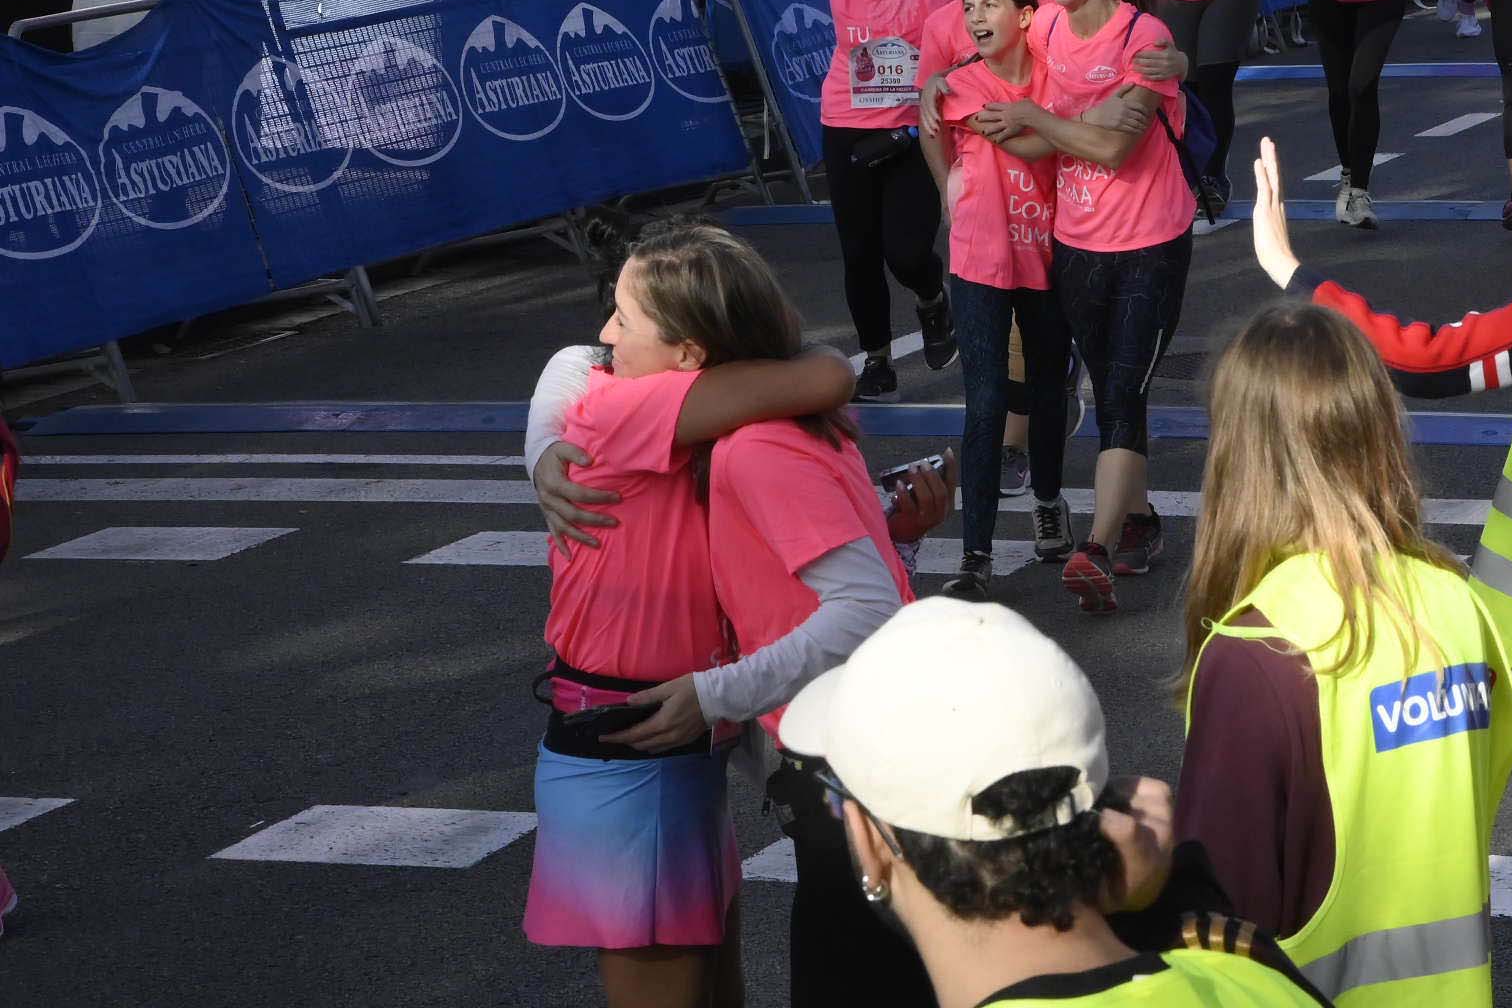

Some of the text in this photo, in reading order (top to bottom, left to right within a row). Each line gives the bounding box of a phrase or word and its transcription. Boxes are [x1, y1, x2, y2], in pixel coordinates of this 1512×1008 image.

[846, 26, 871, 44] TU
[470, 67, 562, 114] ASTURIANA
[565, 50, 650, 96] ASTURIANA
[877, 64, 904, 75] 016
[112, 142, 225, 202] ASTURIANA
